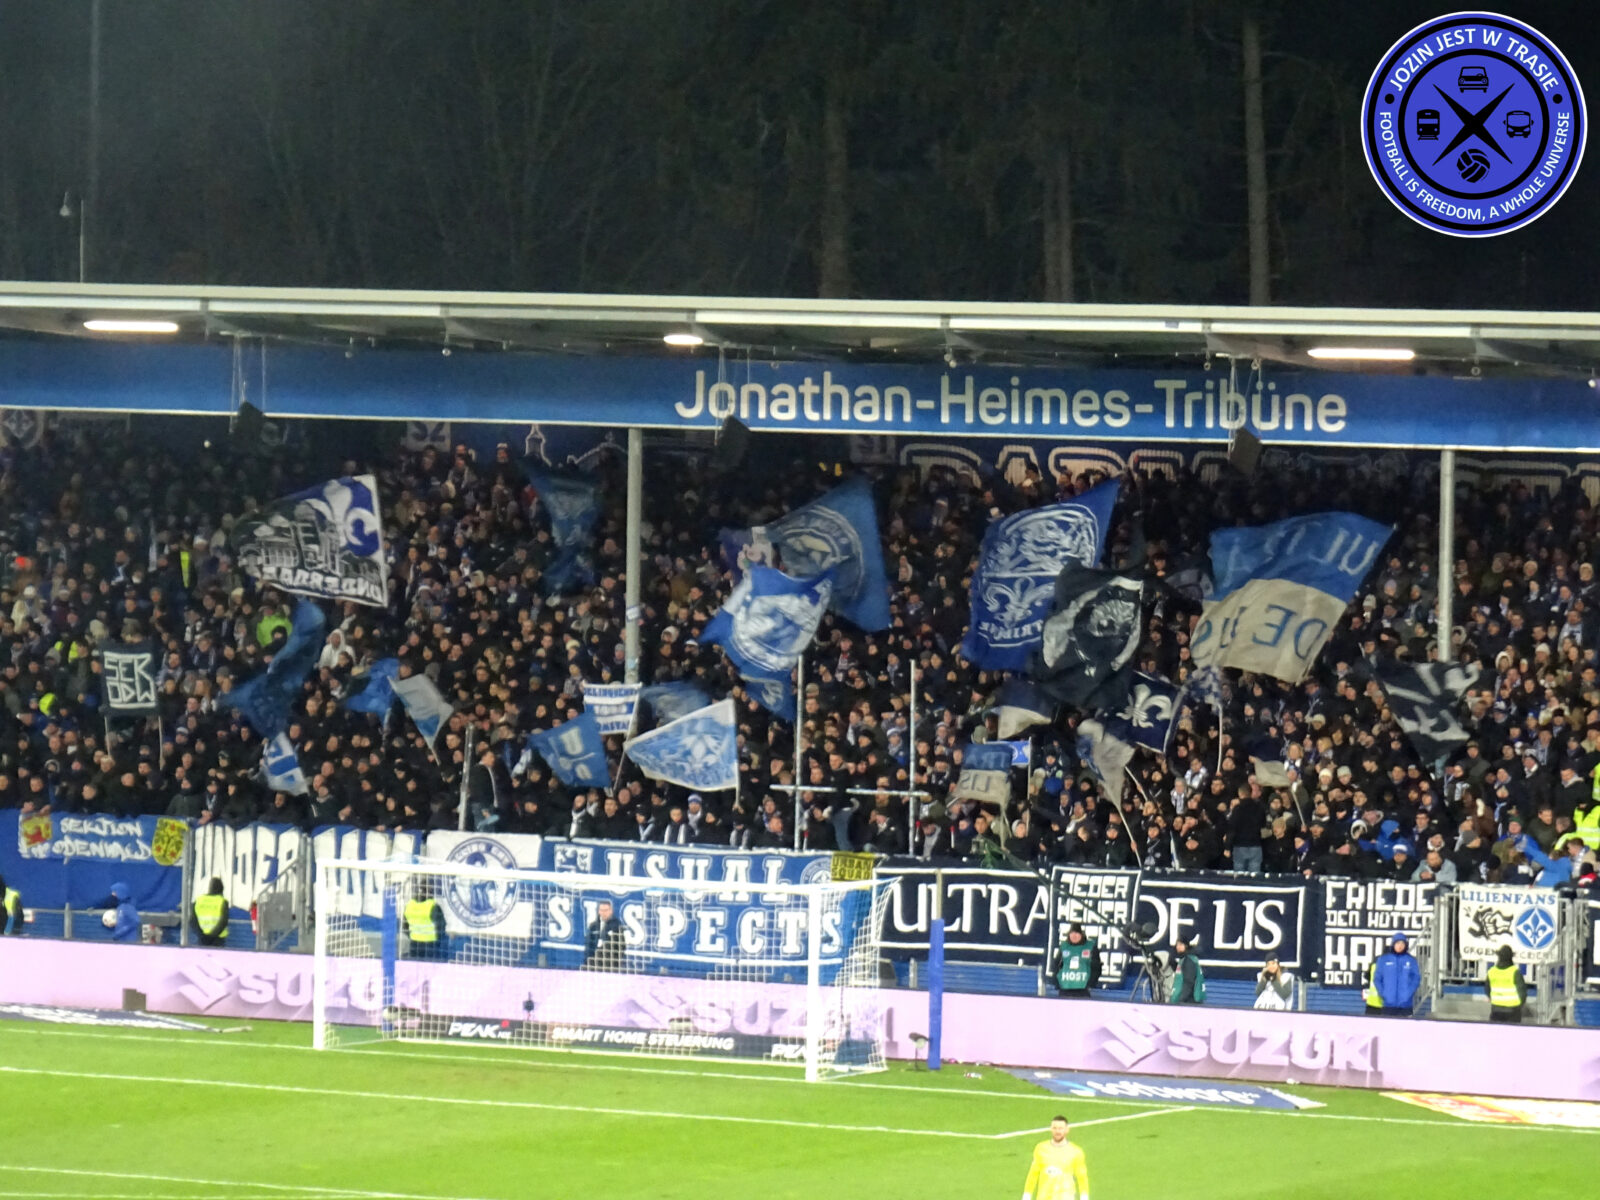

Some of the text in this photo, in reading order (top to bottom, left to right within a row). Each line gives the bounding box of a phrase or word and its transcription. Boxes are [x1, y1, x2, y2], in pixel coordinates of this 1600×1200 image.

[674, 370, 1347, 432] Jonathan-Heimes-Tribüne
[60, 817, 143, 837] SEKTION
[605, 850, 790, 902] USUAL
[1325, 880, 1439, 912] FRIEDE
[1461, 889, 1556, 906] LILIENFANS
[1138, 894, 1200, 947] DE
[1212, 899, 1285, 950] LIS
[1325, 910, 1360, 927] DEN
[1061, 971, 1088, 982] HOST
[1324, 971, 1353, 985] DEN
[552, 1027, 735, 1051] SMART HOME STEUERUNG
[1167, 1025, 1378, 1073] SUZUKI
